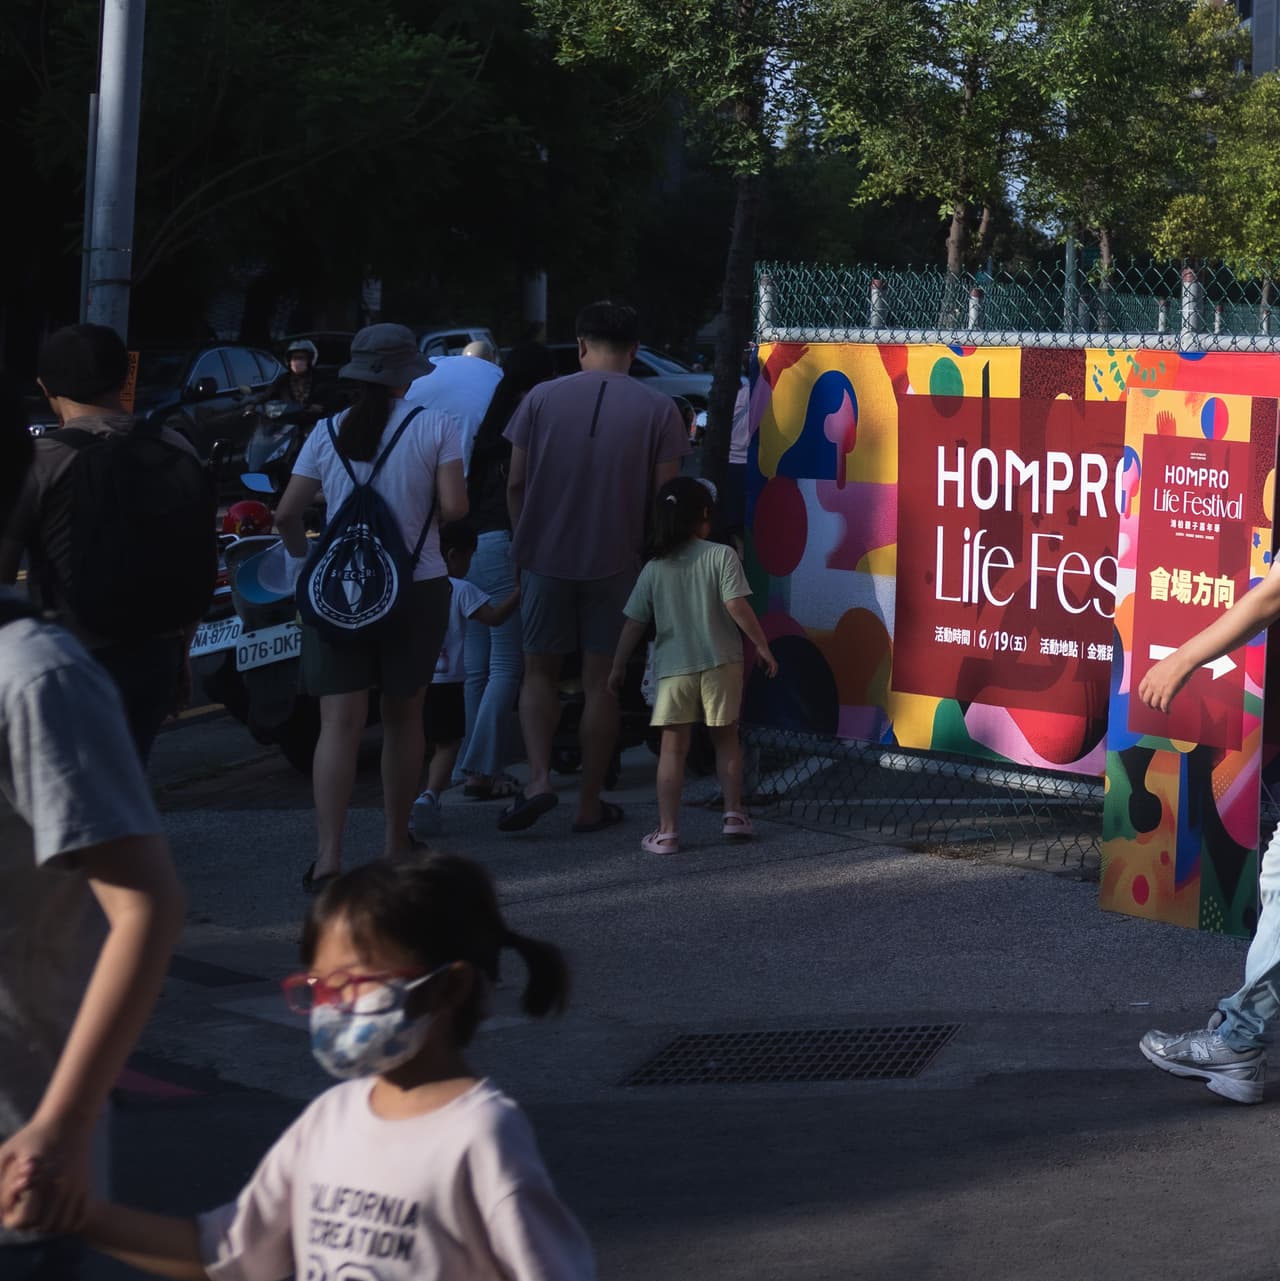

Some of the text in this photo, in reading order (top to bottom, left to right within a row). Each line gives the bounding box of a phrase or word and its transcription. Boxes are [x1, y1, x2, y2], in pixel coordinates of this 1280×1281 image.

[1165, 465, 1229, 489] HOMPRO
[1154, 488, 1243, 520] Life Festival
[936, 525, 1015, 607] Life
[1149, 566, 1235, 609] 會場方向
